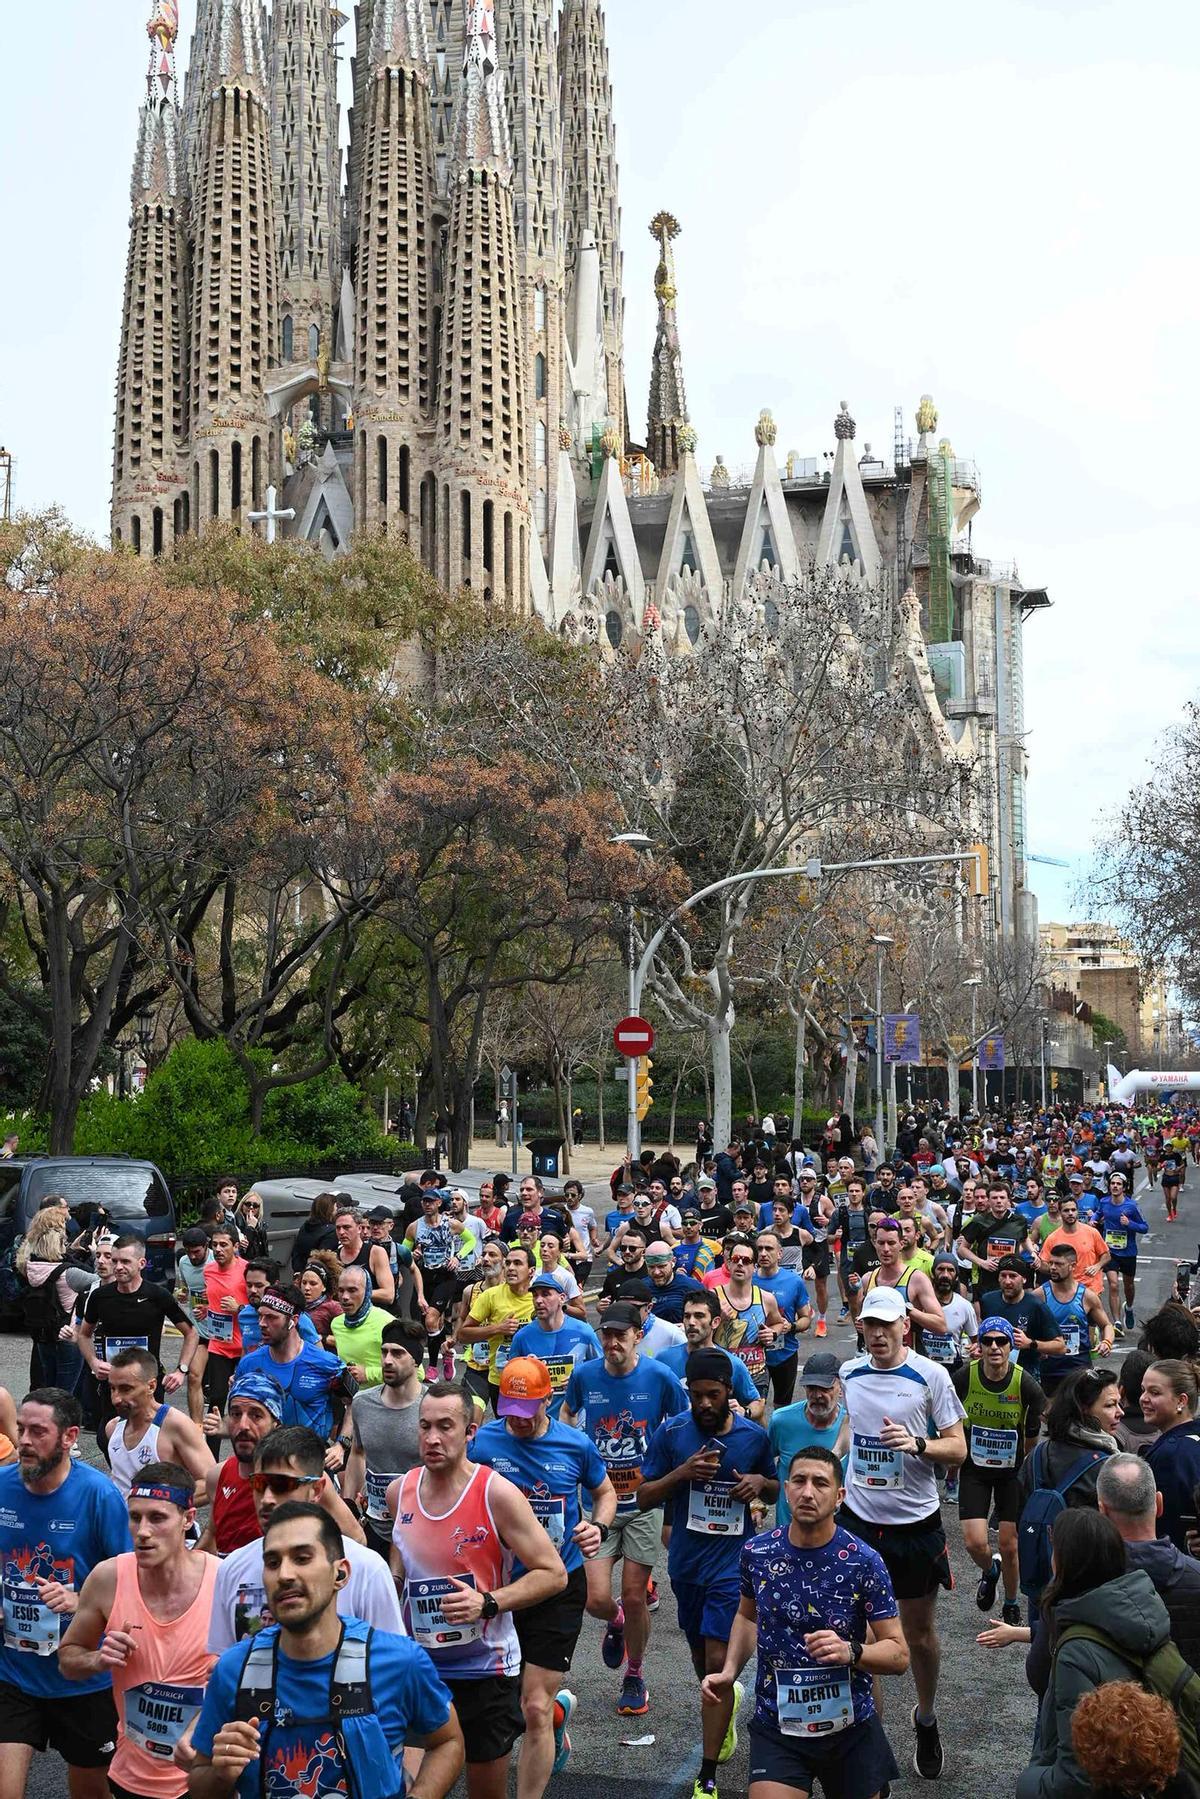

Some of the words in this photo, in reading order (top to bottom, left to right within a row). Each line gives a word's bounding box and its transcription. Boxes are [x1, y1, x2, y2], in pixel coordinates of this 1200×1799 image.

[1160, 1074, 1188, 1082] YAMAHA
[546, 1160, 554, 1170] P
[979, 1409, 1021, 1419] FIORINO
[975, 1437, 1013, 1450] MAURIZIO
[857, 1448, 895, 1463] MATTIAS
[704, 1494, 733, 1509] KEVIN
[12, 1603, 40, 1622] JESÚS
[18, 1622, 32, 1633] 1323
[804, 1673, 831, 1682] ZURICH
[153, 1688, 185, 1701] ZURICH
[787, 1683, 840, 1704] ALBERTO
[138, 1696, 184, 1724] DANIEL
[807, 1704, 822, 1715] 979
[146, 1720, 168, 1734] 5809
